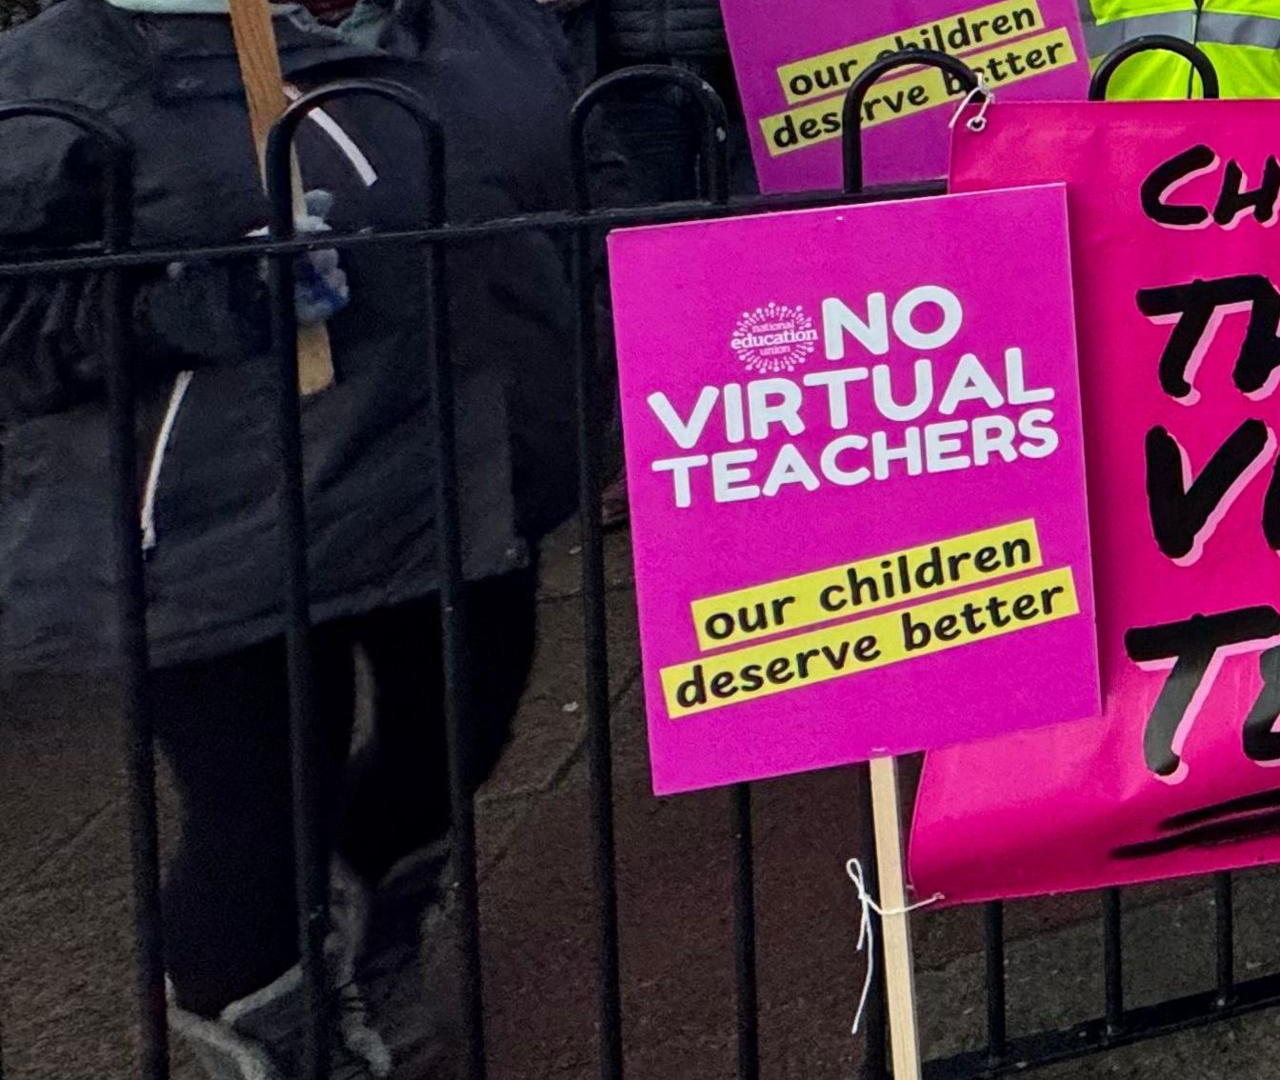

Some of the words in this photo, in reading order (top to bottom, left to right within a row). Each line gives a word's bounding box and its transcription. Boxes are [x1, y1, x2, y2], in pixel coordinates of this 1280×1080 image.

[773, 84, 929, 148] desrve
[941, 40, 1064, 95] btter
[789, 59, 858, 96] our
[731, 329, 818, 350] education
[822, 285, 963, 360] NO
[647, 347, 1056, 449] VIRTUAL
[651, 409, 1059, 508] TEACHERS
[704, 593, 796, 641] our
[820, 533, 1031, 613] children
[675, 634, 881, 708] deserve
[903, 582, 1064, 652] better
